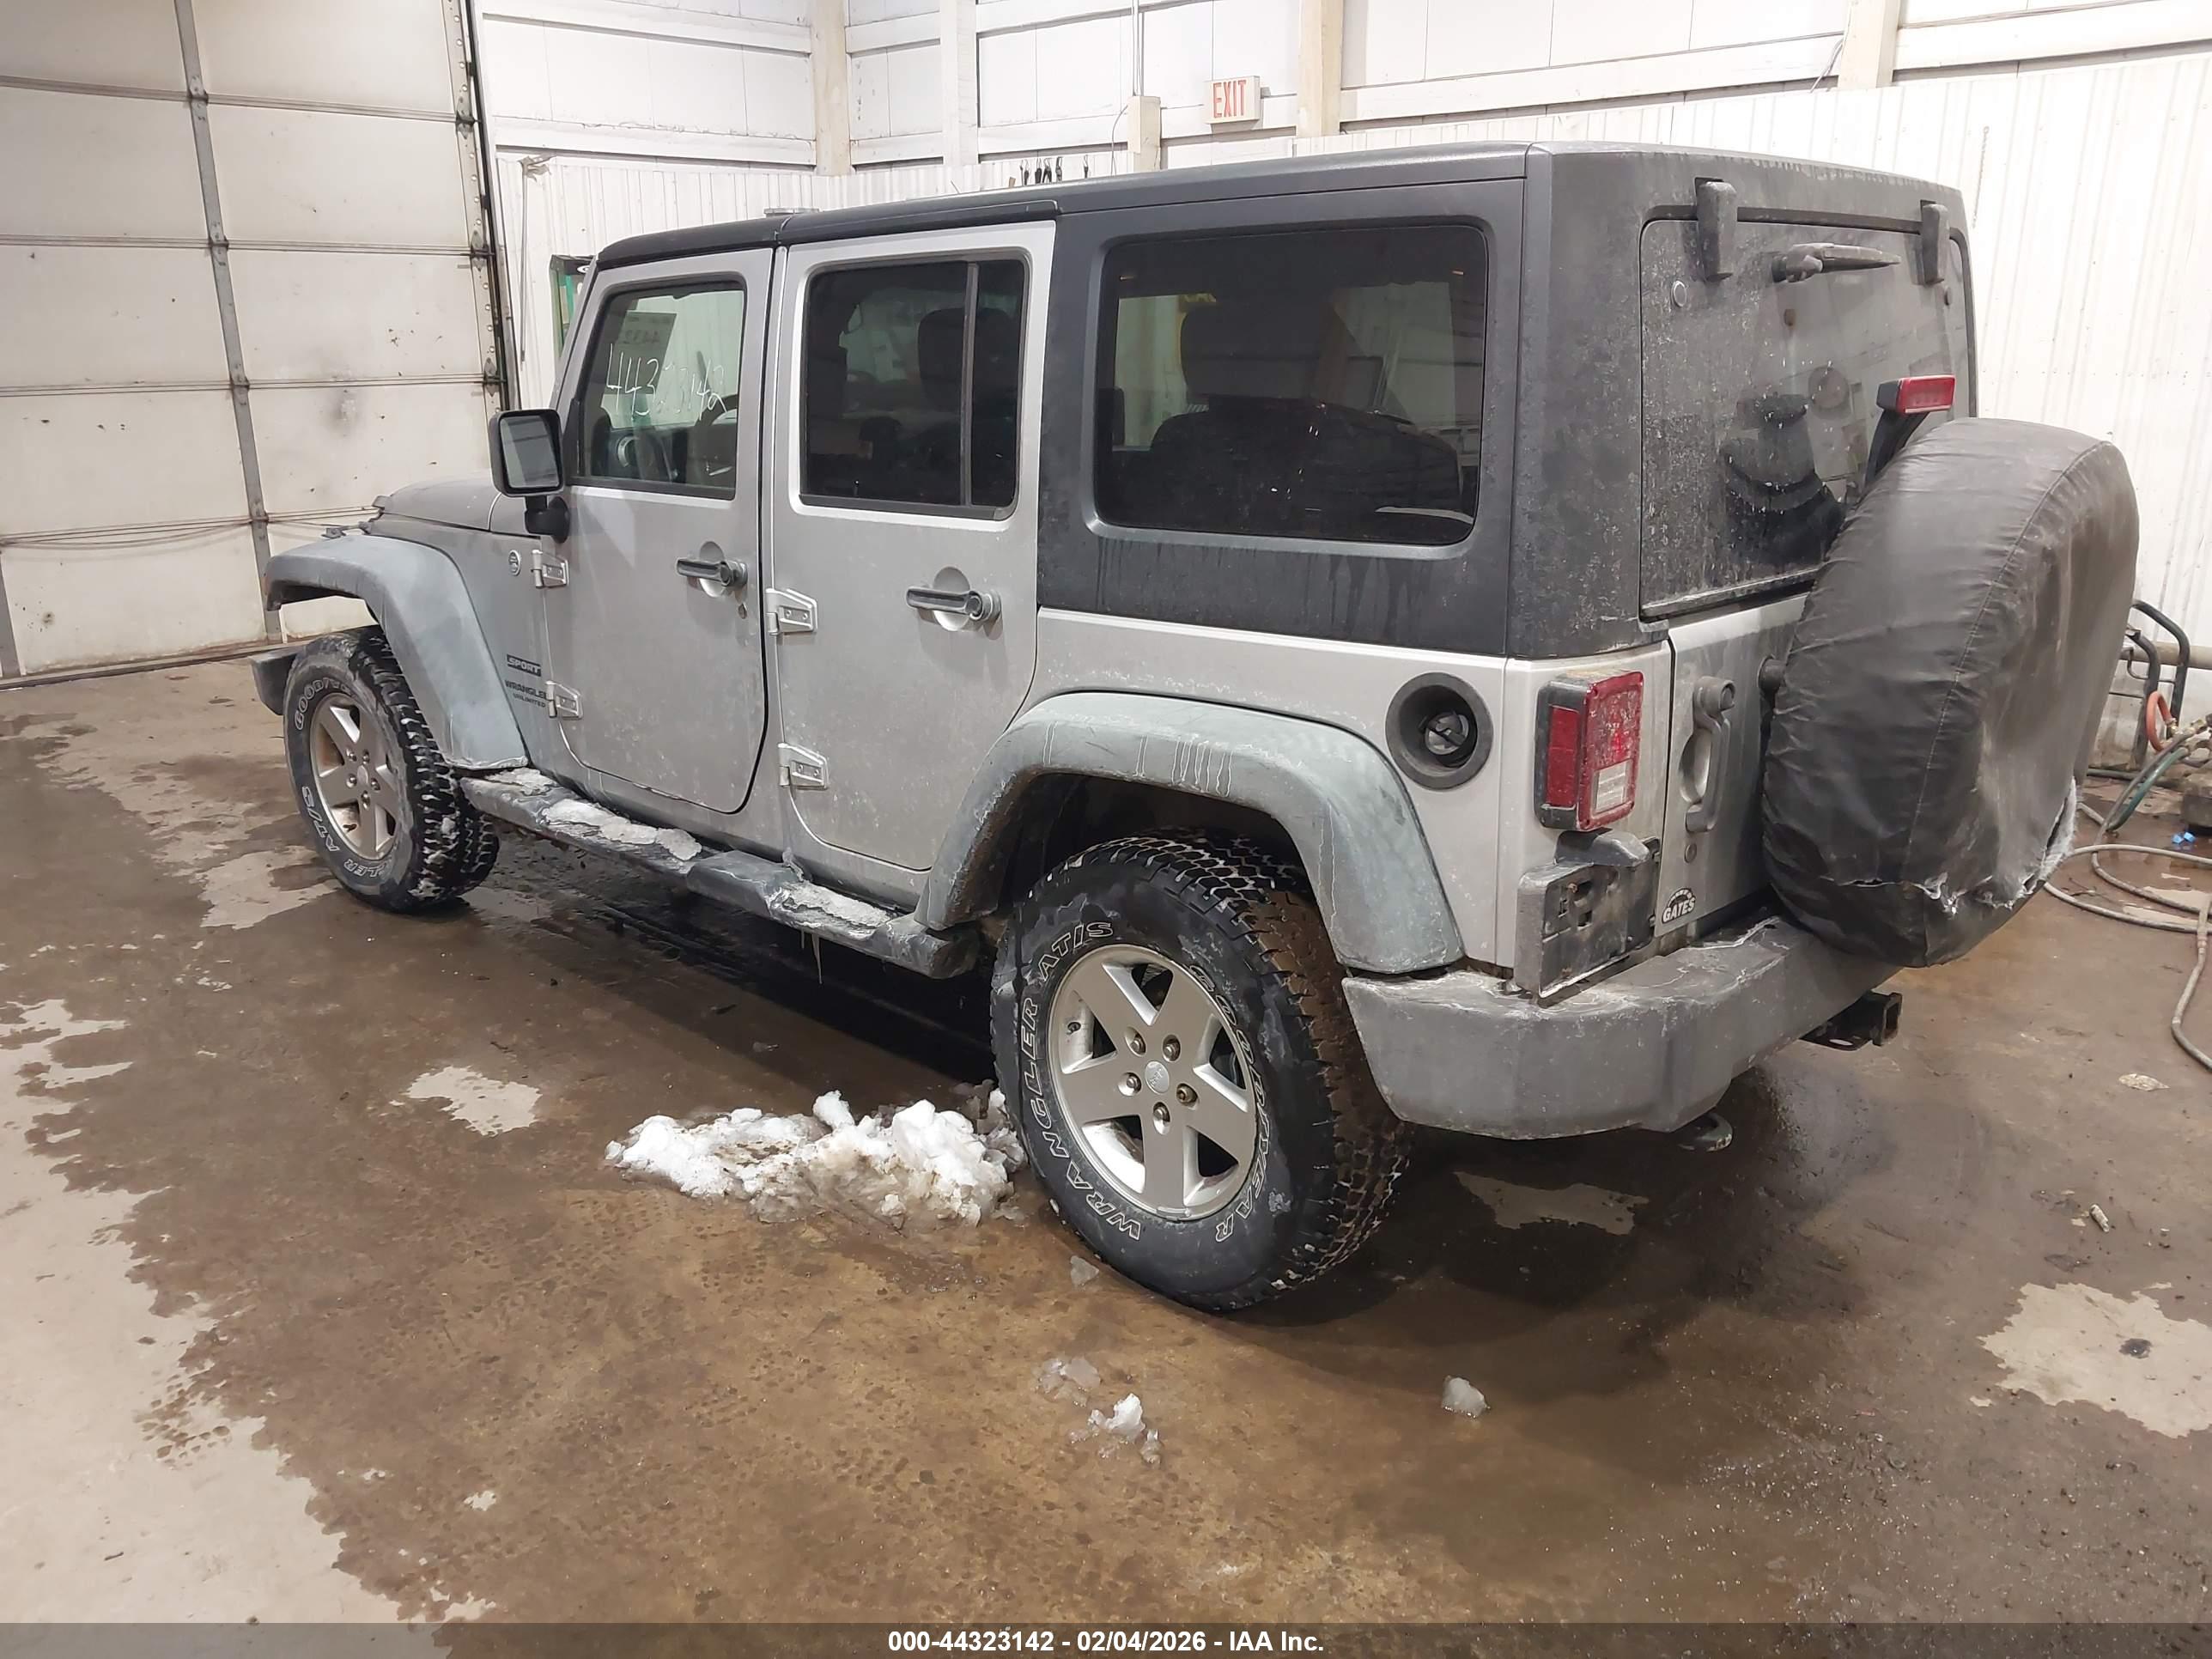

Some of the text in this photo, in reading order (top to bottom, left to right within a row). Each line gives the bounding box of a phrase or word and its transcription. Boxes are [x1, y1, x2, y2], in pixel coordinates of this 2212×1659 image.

[1212, 79, 1247, 118] EXIT
[508, 657, 540, 674] SPORT
[1662, 896, 1696, 923] GATES
[1021, 997, 1142, 1241] WRANGLER
